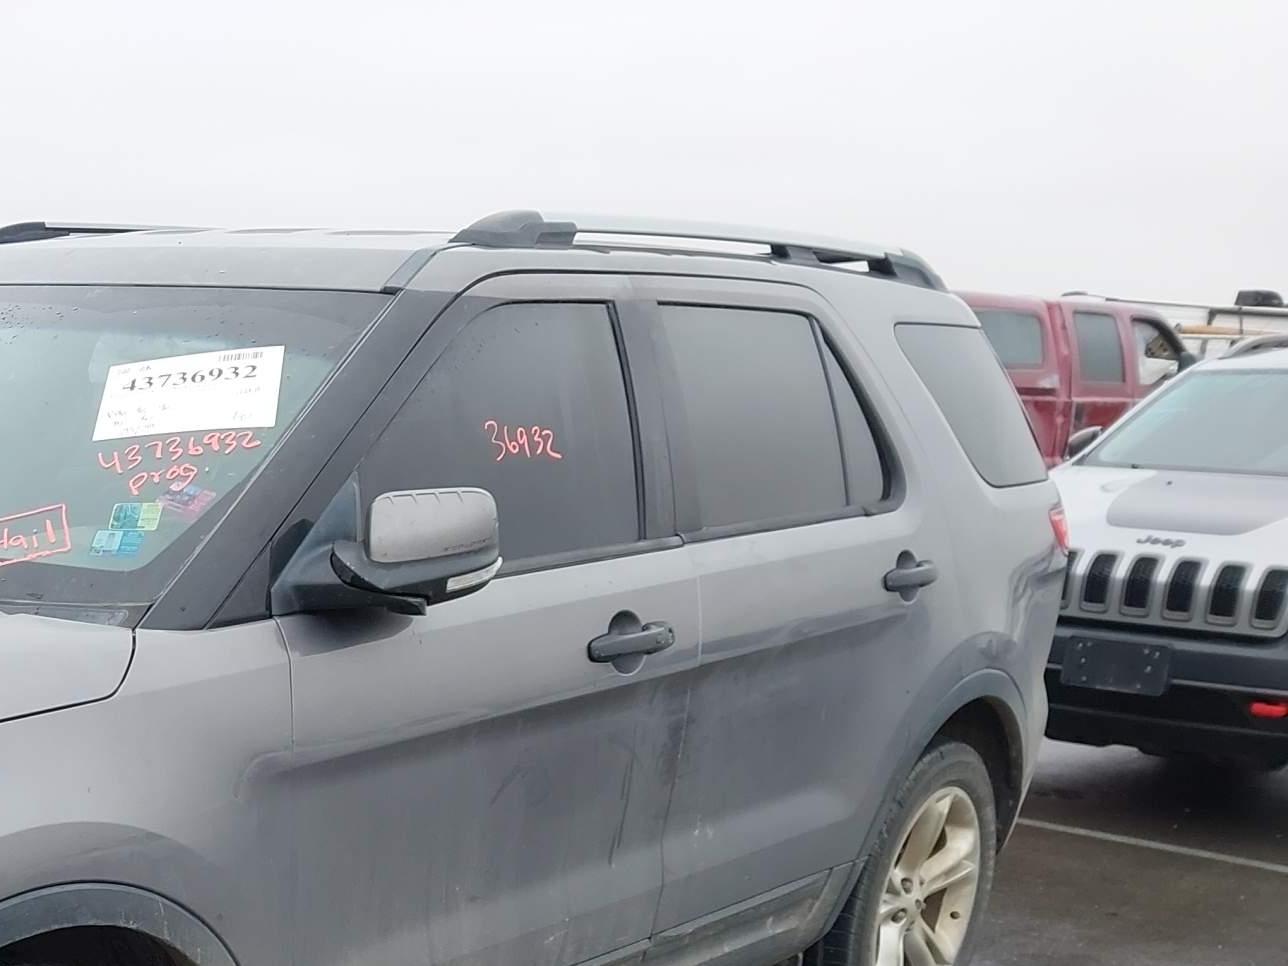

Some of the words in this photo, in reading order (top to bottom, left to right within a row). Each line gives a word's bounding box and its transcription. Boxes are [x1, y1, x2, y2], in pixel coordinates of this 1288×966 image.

[122, 364, 258, 392] 43736932
[98, 431, 261, 474] 43736932
[484, 420, 562, 461] 36932
